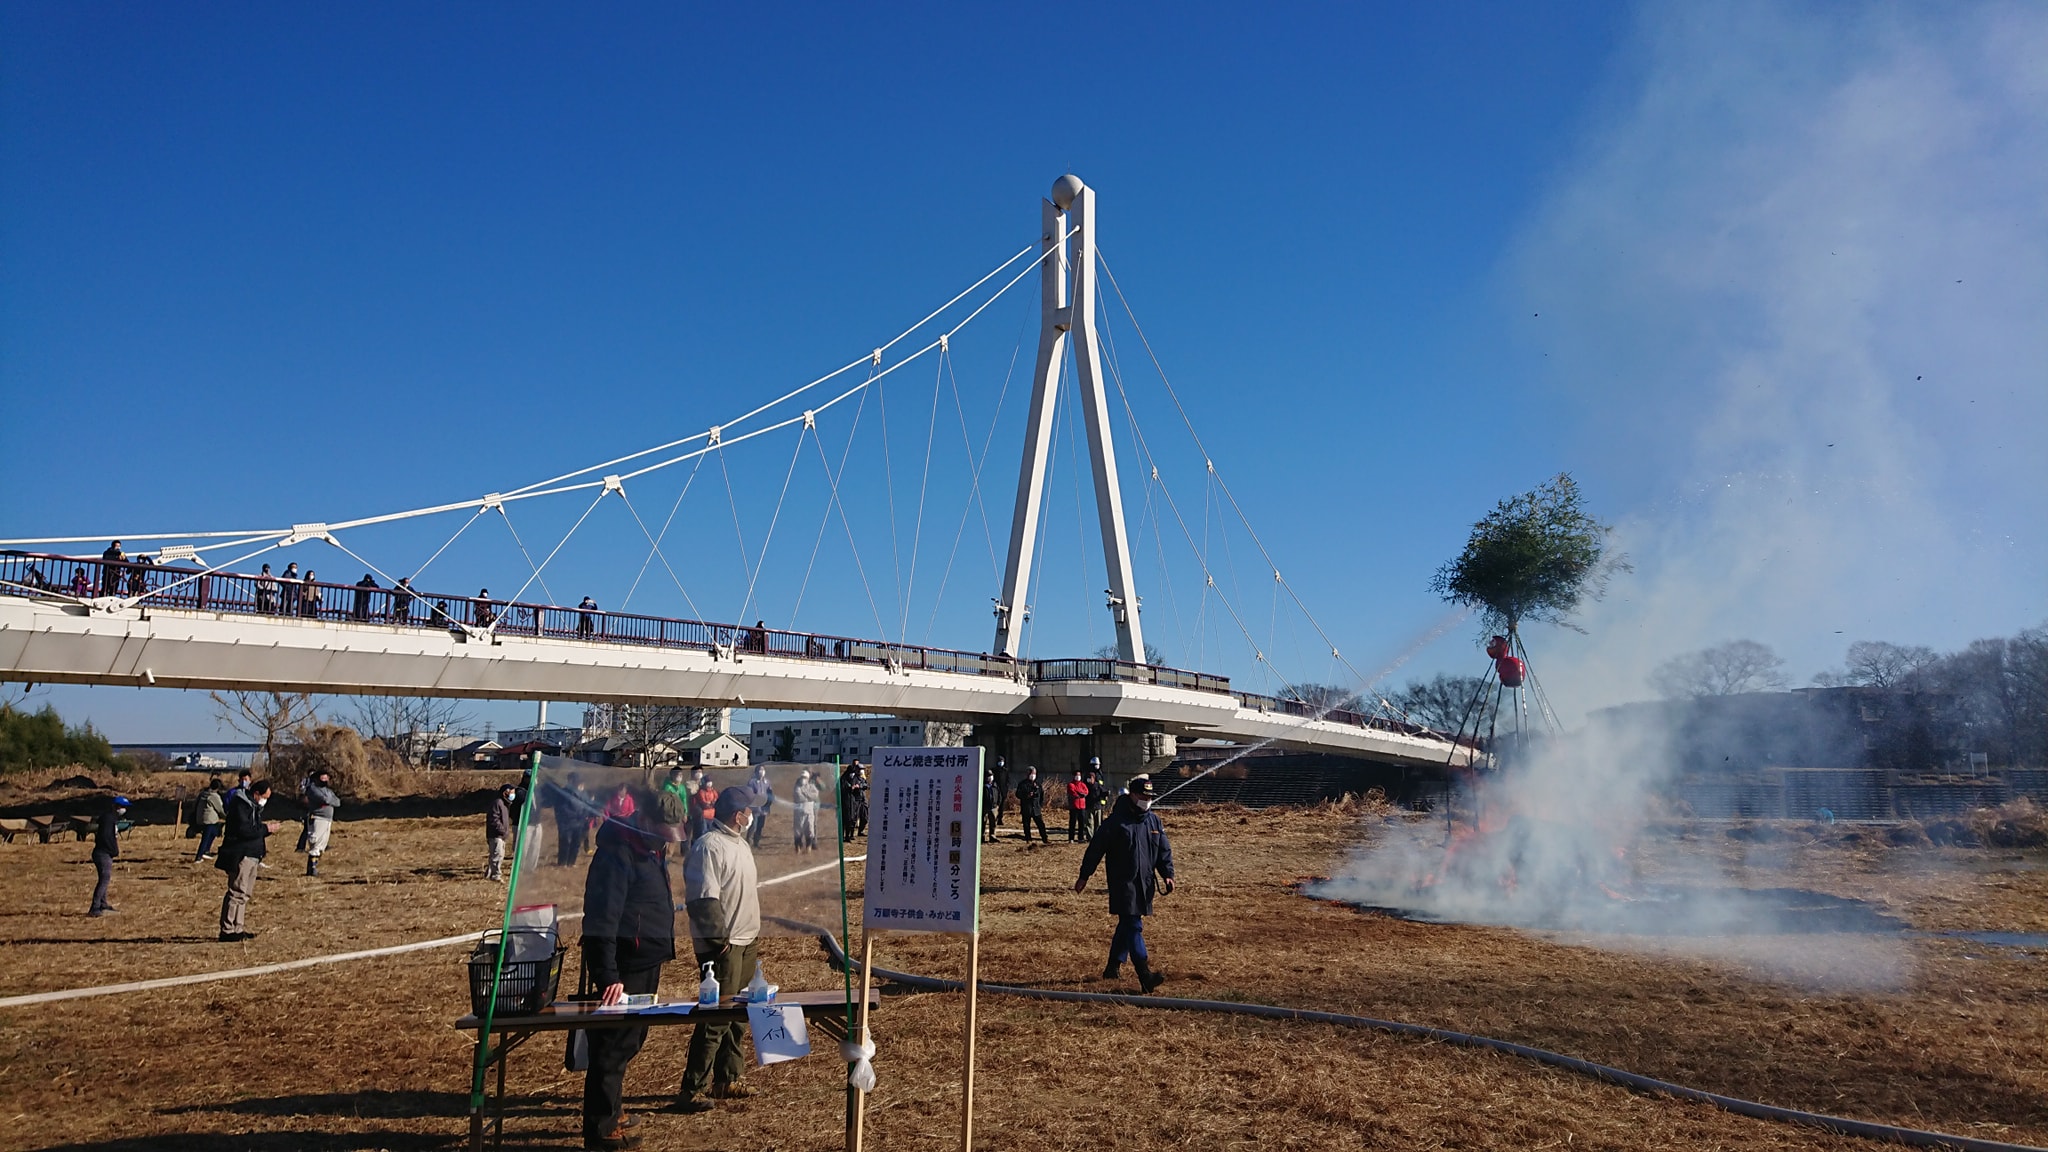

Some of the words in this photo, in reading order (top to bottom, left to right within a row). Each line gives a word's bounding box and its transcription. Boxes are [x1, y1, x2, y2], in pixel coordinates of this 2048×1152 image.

[883, 755, 968, 768] どんど焼き受付所
[953, 774, 963, 812] 点火時間
